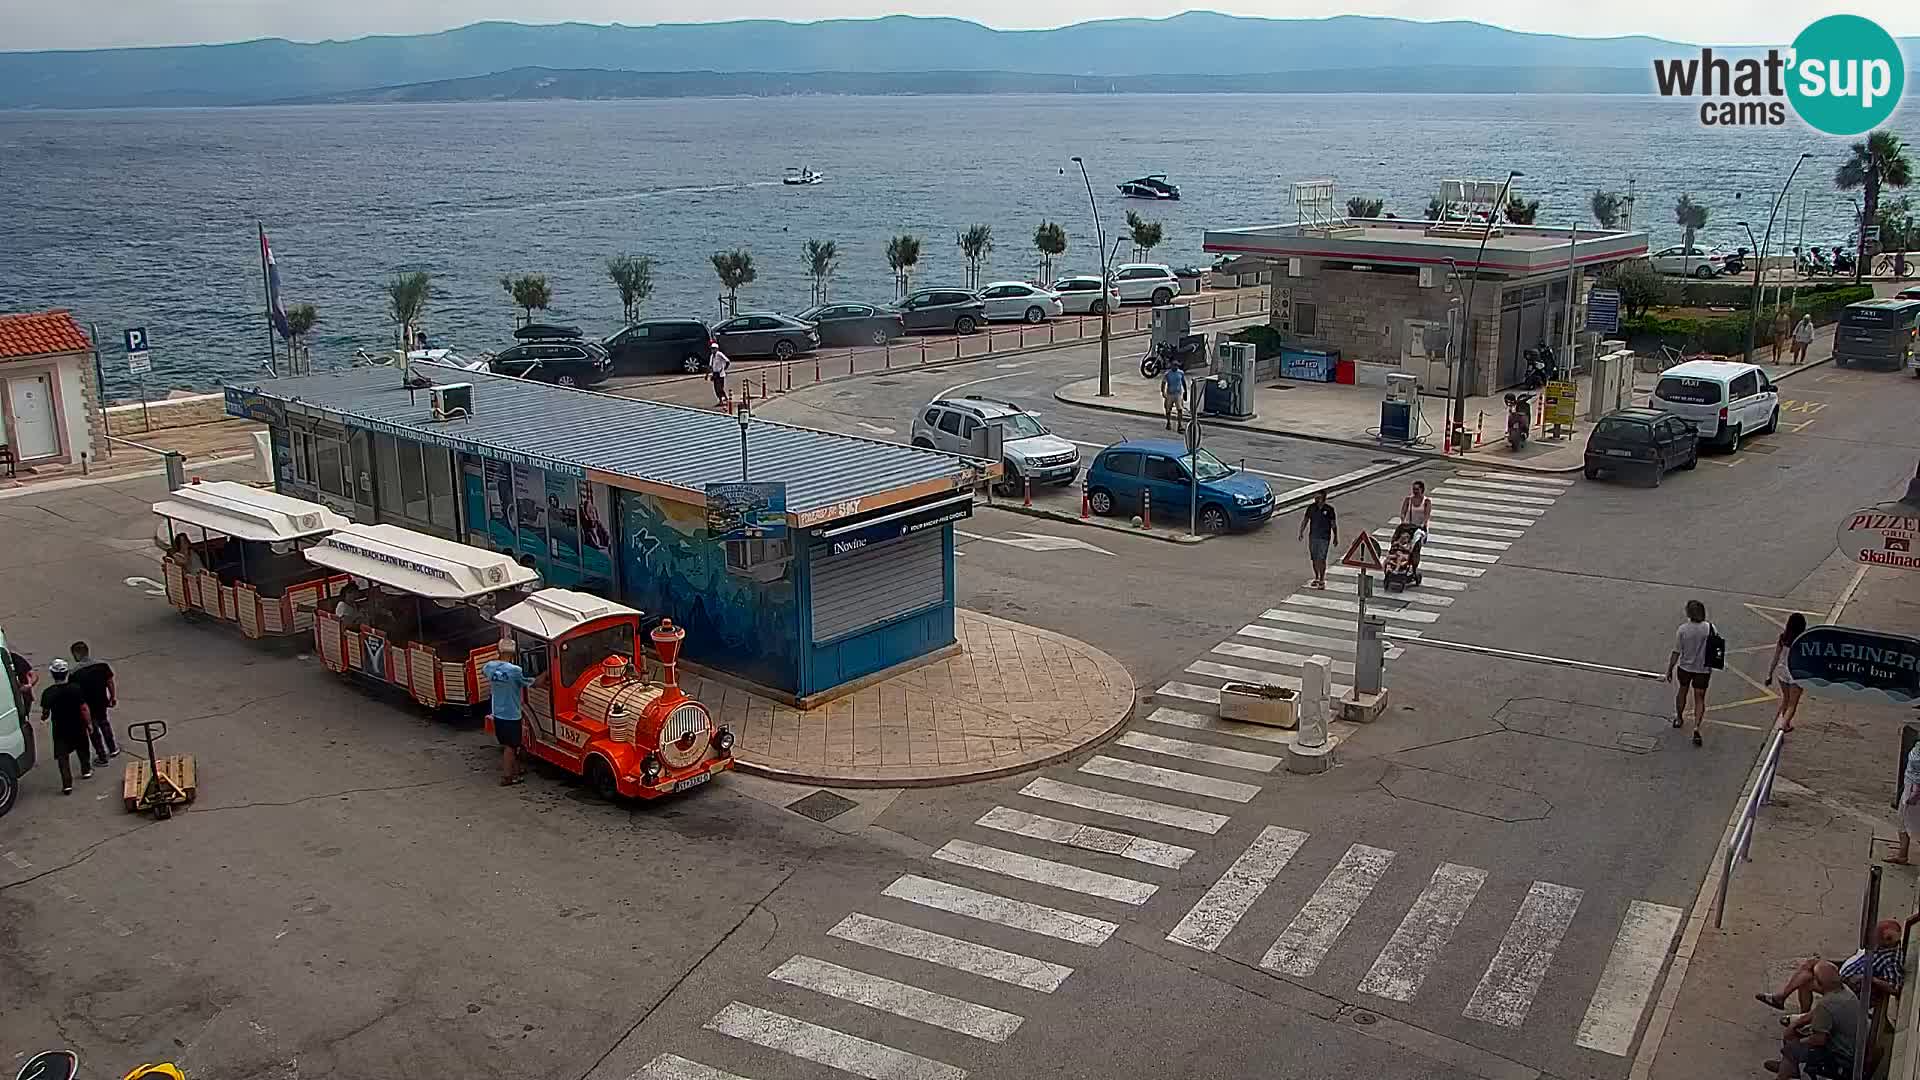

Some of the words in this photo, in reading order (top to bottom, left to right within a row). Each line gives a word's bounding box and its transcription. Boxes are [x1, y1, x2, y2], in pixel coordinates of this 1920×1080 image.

[129, 331, 142, 349] P
[1681, 379, 1699, 387] TAXI
[478, 446, 493, 458] BUS
[494, 449, 526, 465] STATION
[527, 457, 553, 471] TICKET
[555, 463, 582, 477] OFFICE
[1848, 515, 1920, 533] PIZZE
[1881, 529, 1913, 539] GRILL
[1800, 641, 1920, 673] MARINER
[1827, 661, 1866, 674] caffe
[1870, 665, 1896, 680] bar
